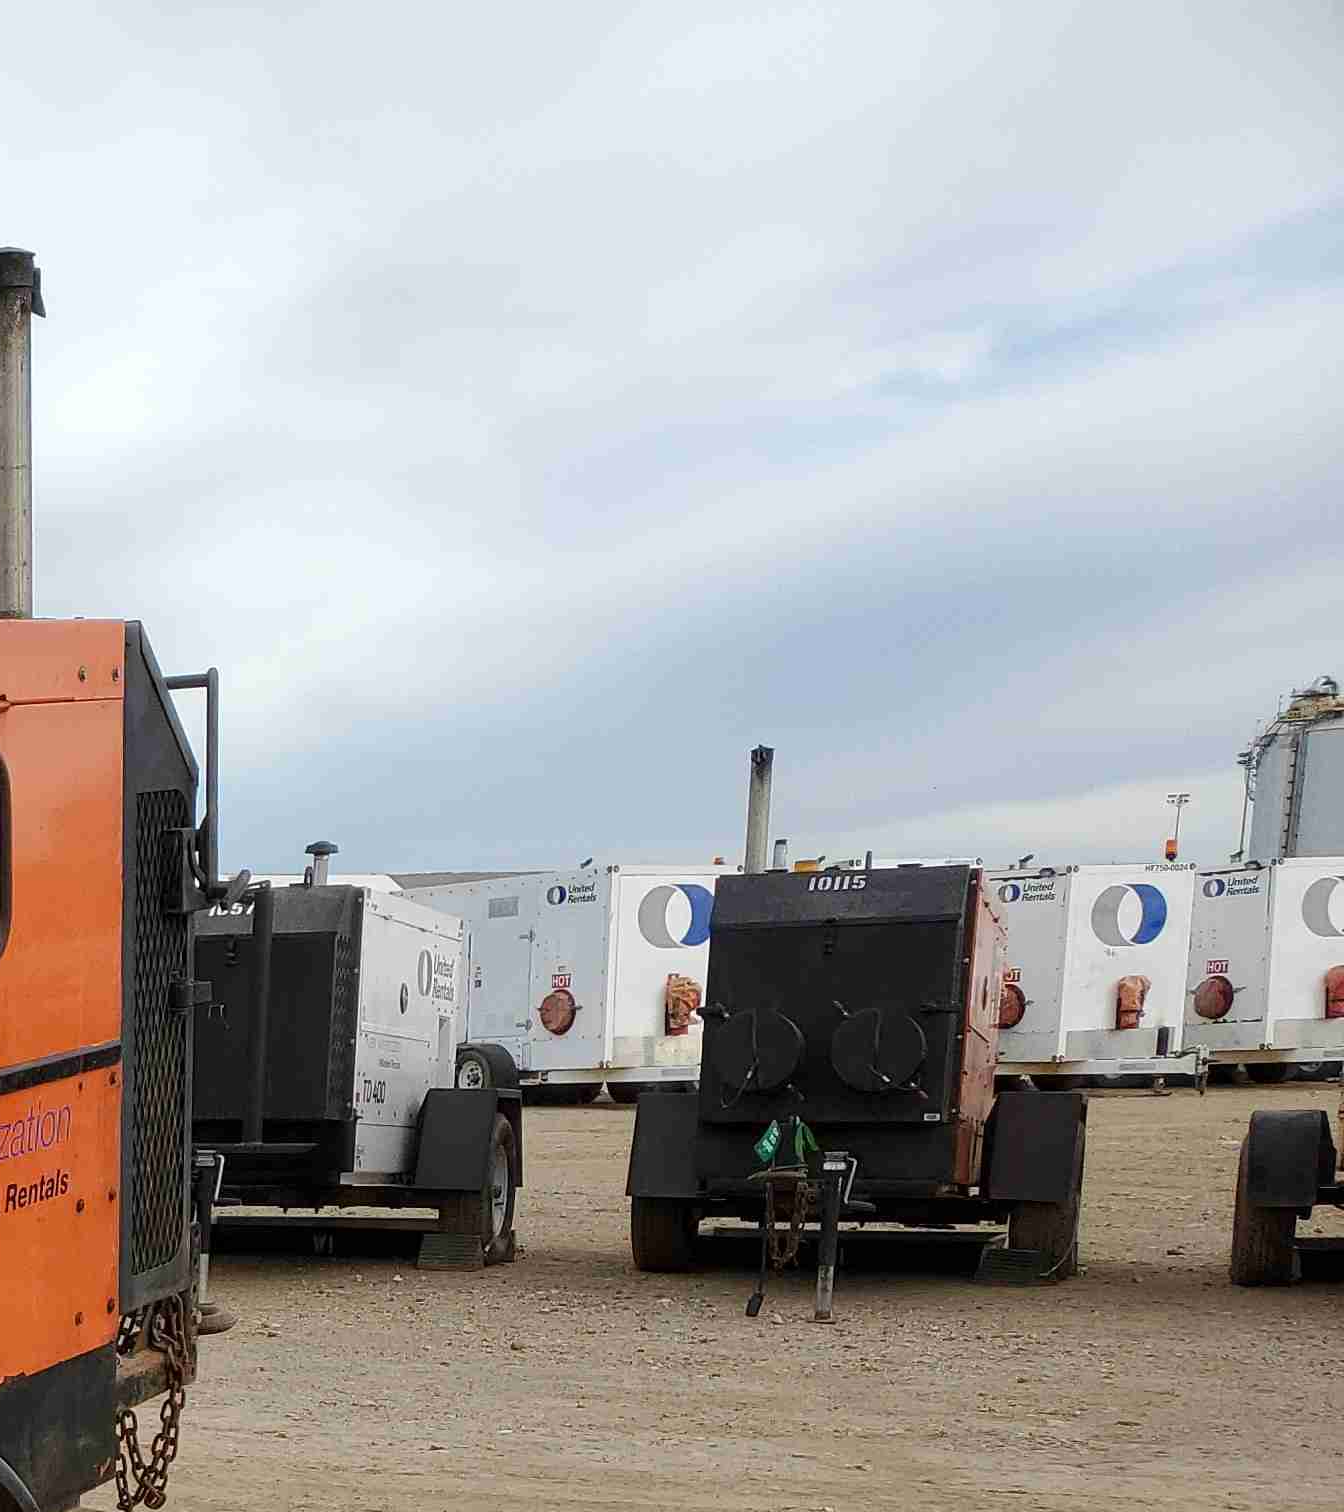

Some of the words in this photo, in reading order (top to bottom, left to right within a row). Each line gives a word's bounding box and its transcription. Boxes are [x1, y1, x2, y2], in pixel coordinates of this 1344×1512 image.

[808, 875, 867, 891] 10115
[1207, 961, 1228, 973] HOT
[553, 975, 571, 987] HOT
[5, 1169, 69, 1213] Rentals
